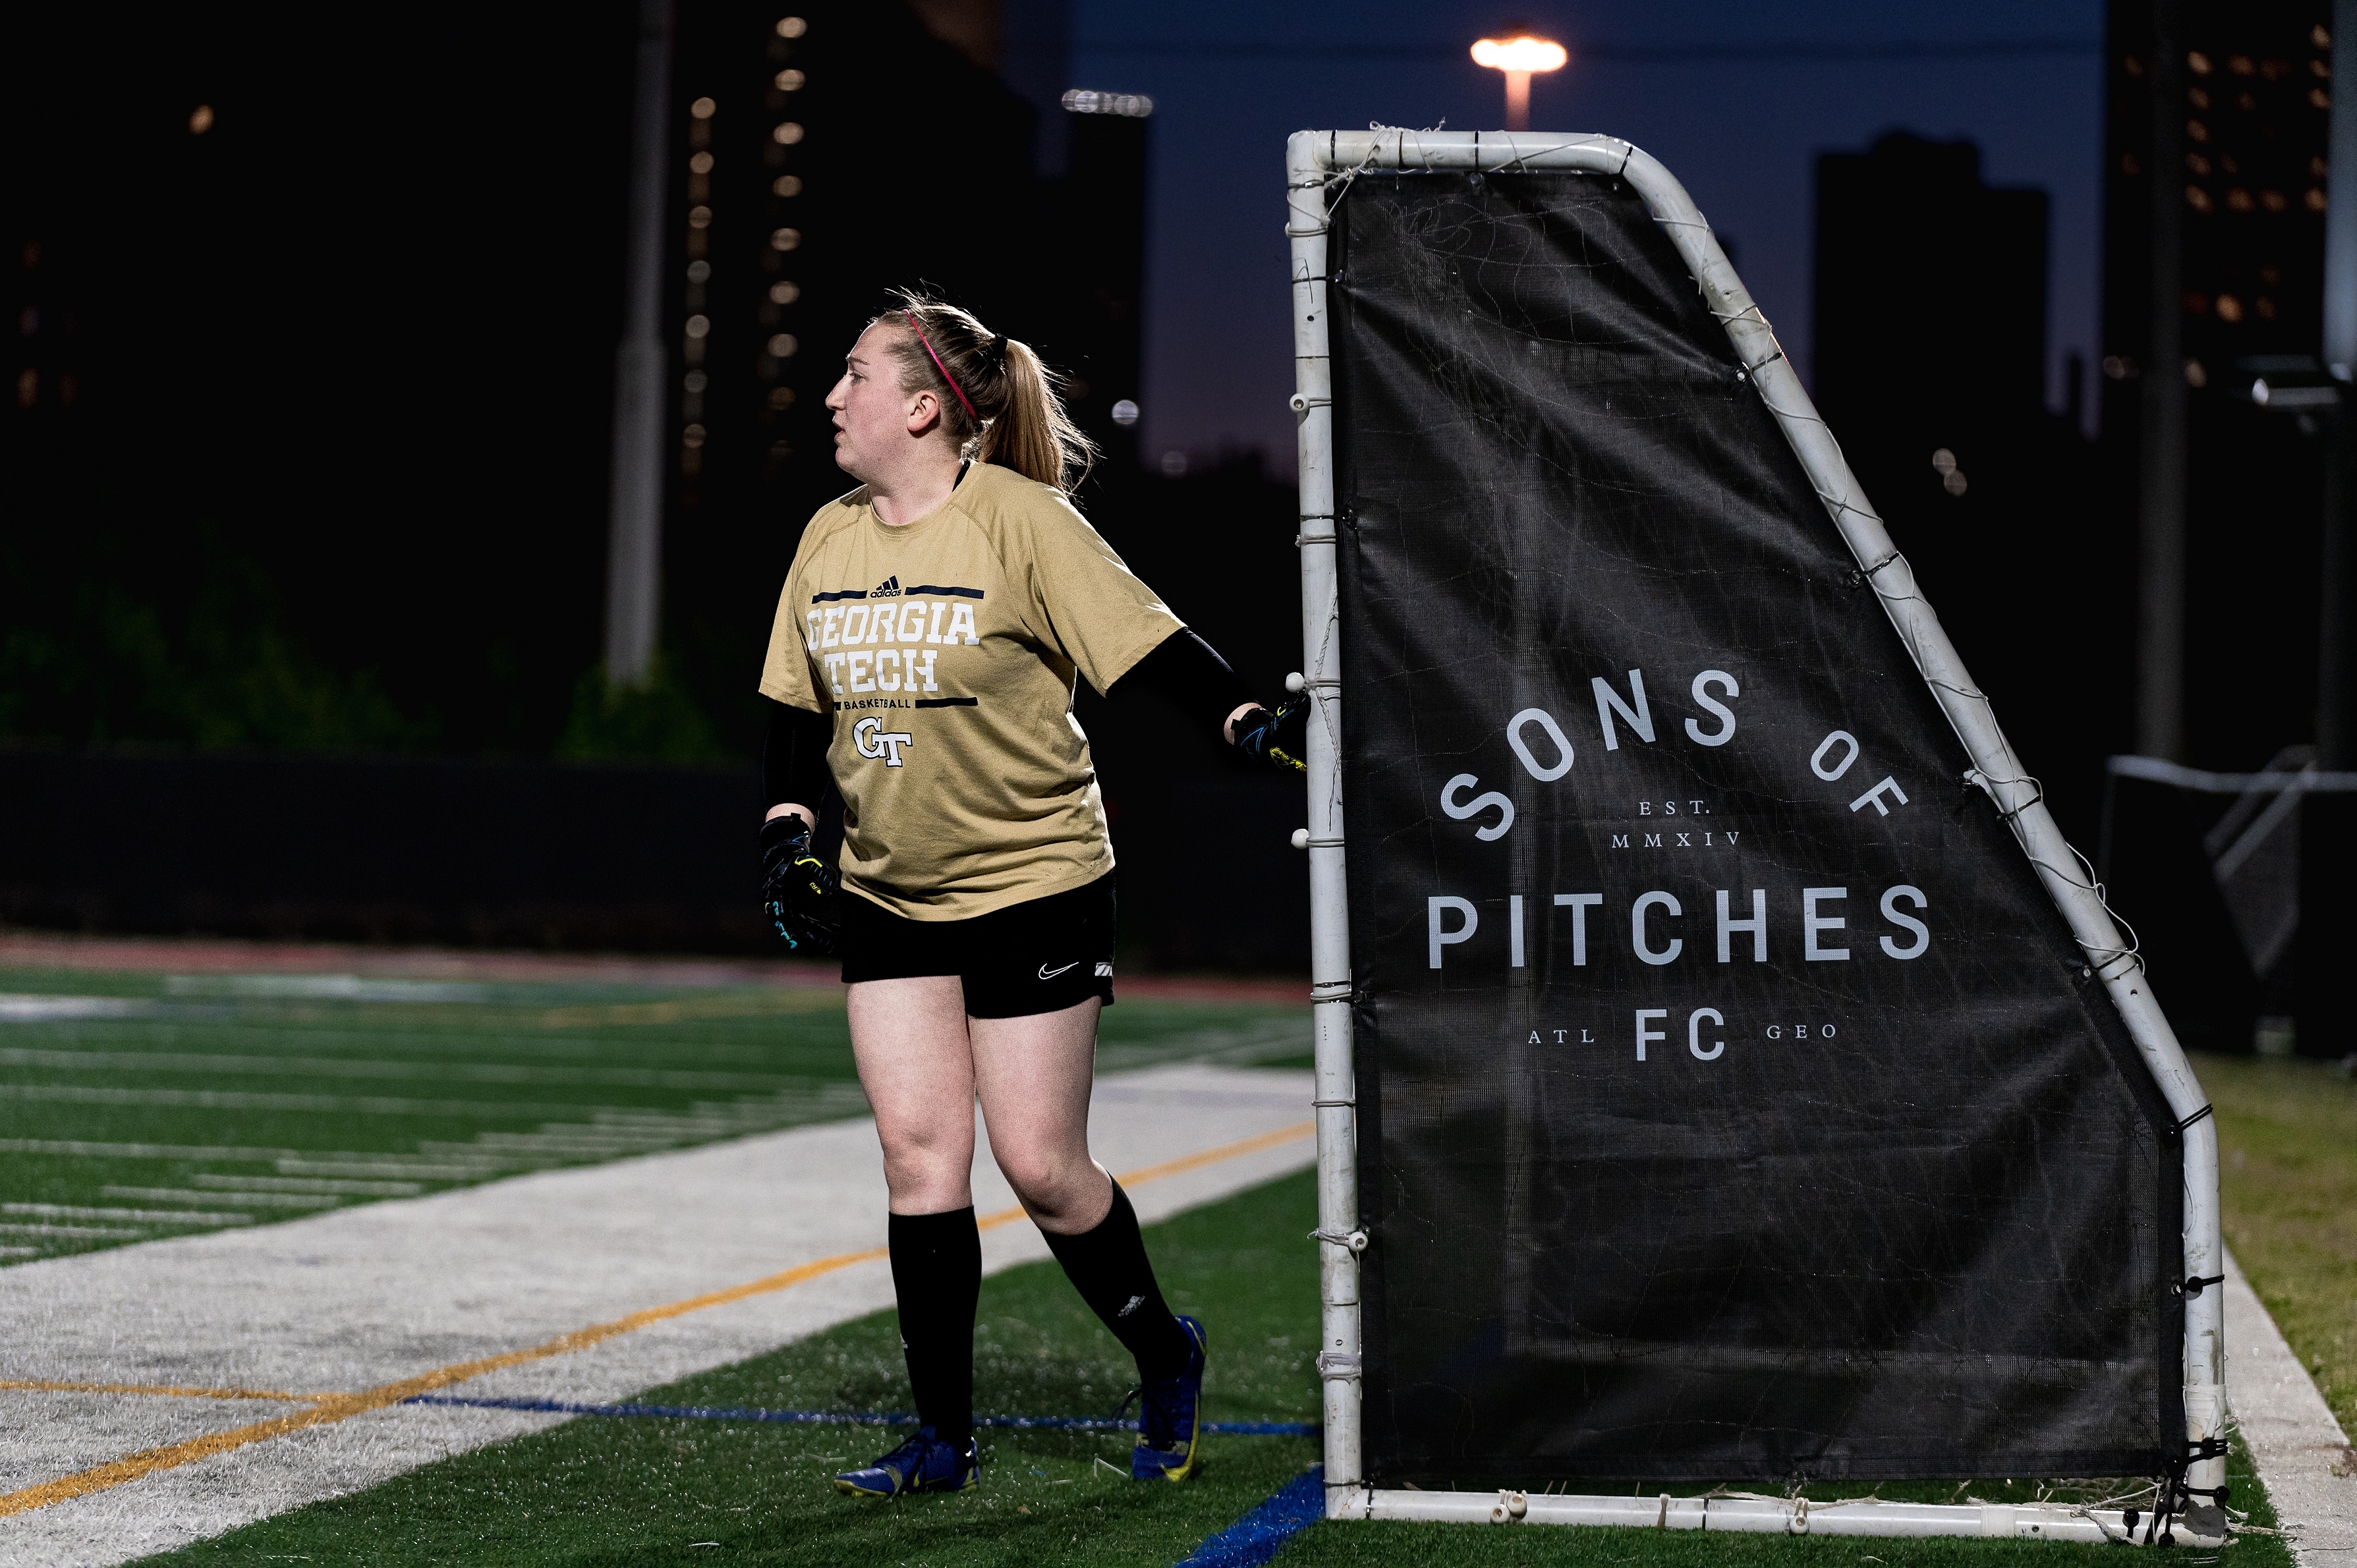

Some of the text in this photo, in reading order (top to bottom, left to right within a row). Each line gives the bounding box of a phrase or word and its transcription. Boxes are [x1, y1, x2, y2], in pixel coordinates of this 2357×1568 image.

[870, 589, 902, 598] adidas
[807, 601, 980, 651] GEORGIA
[824, 649, 938, 694] TECH
[843, 698, 911, 710] BASKETBALL
[852, 716, 913, 768] GT
[1440, 668, 1909, 841] SONS OF
[1639, 800, 1710, 816] EST.
[1612, 831, 1740, 849] MMXIV
[1428, 885, 1930, 969] PITCHES
[1528, 1007, 1836, 1061] ATL FC GEO
